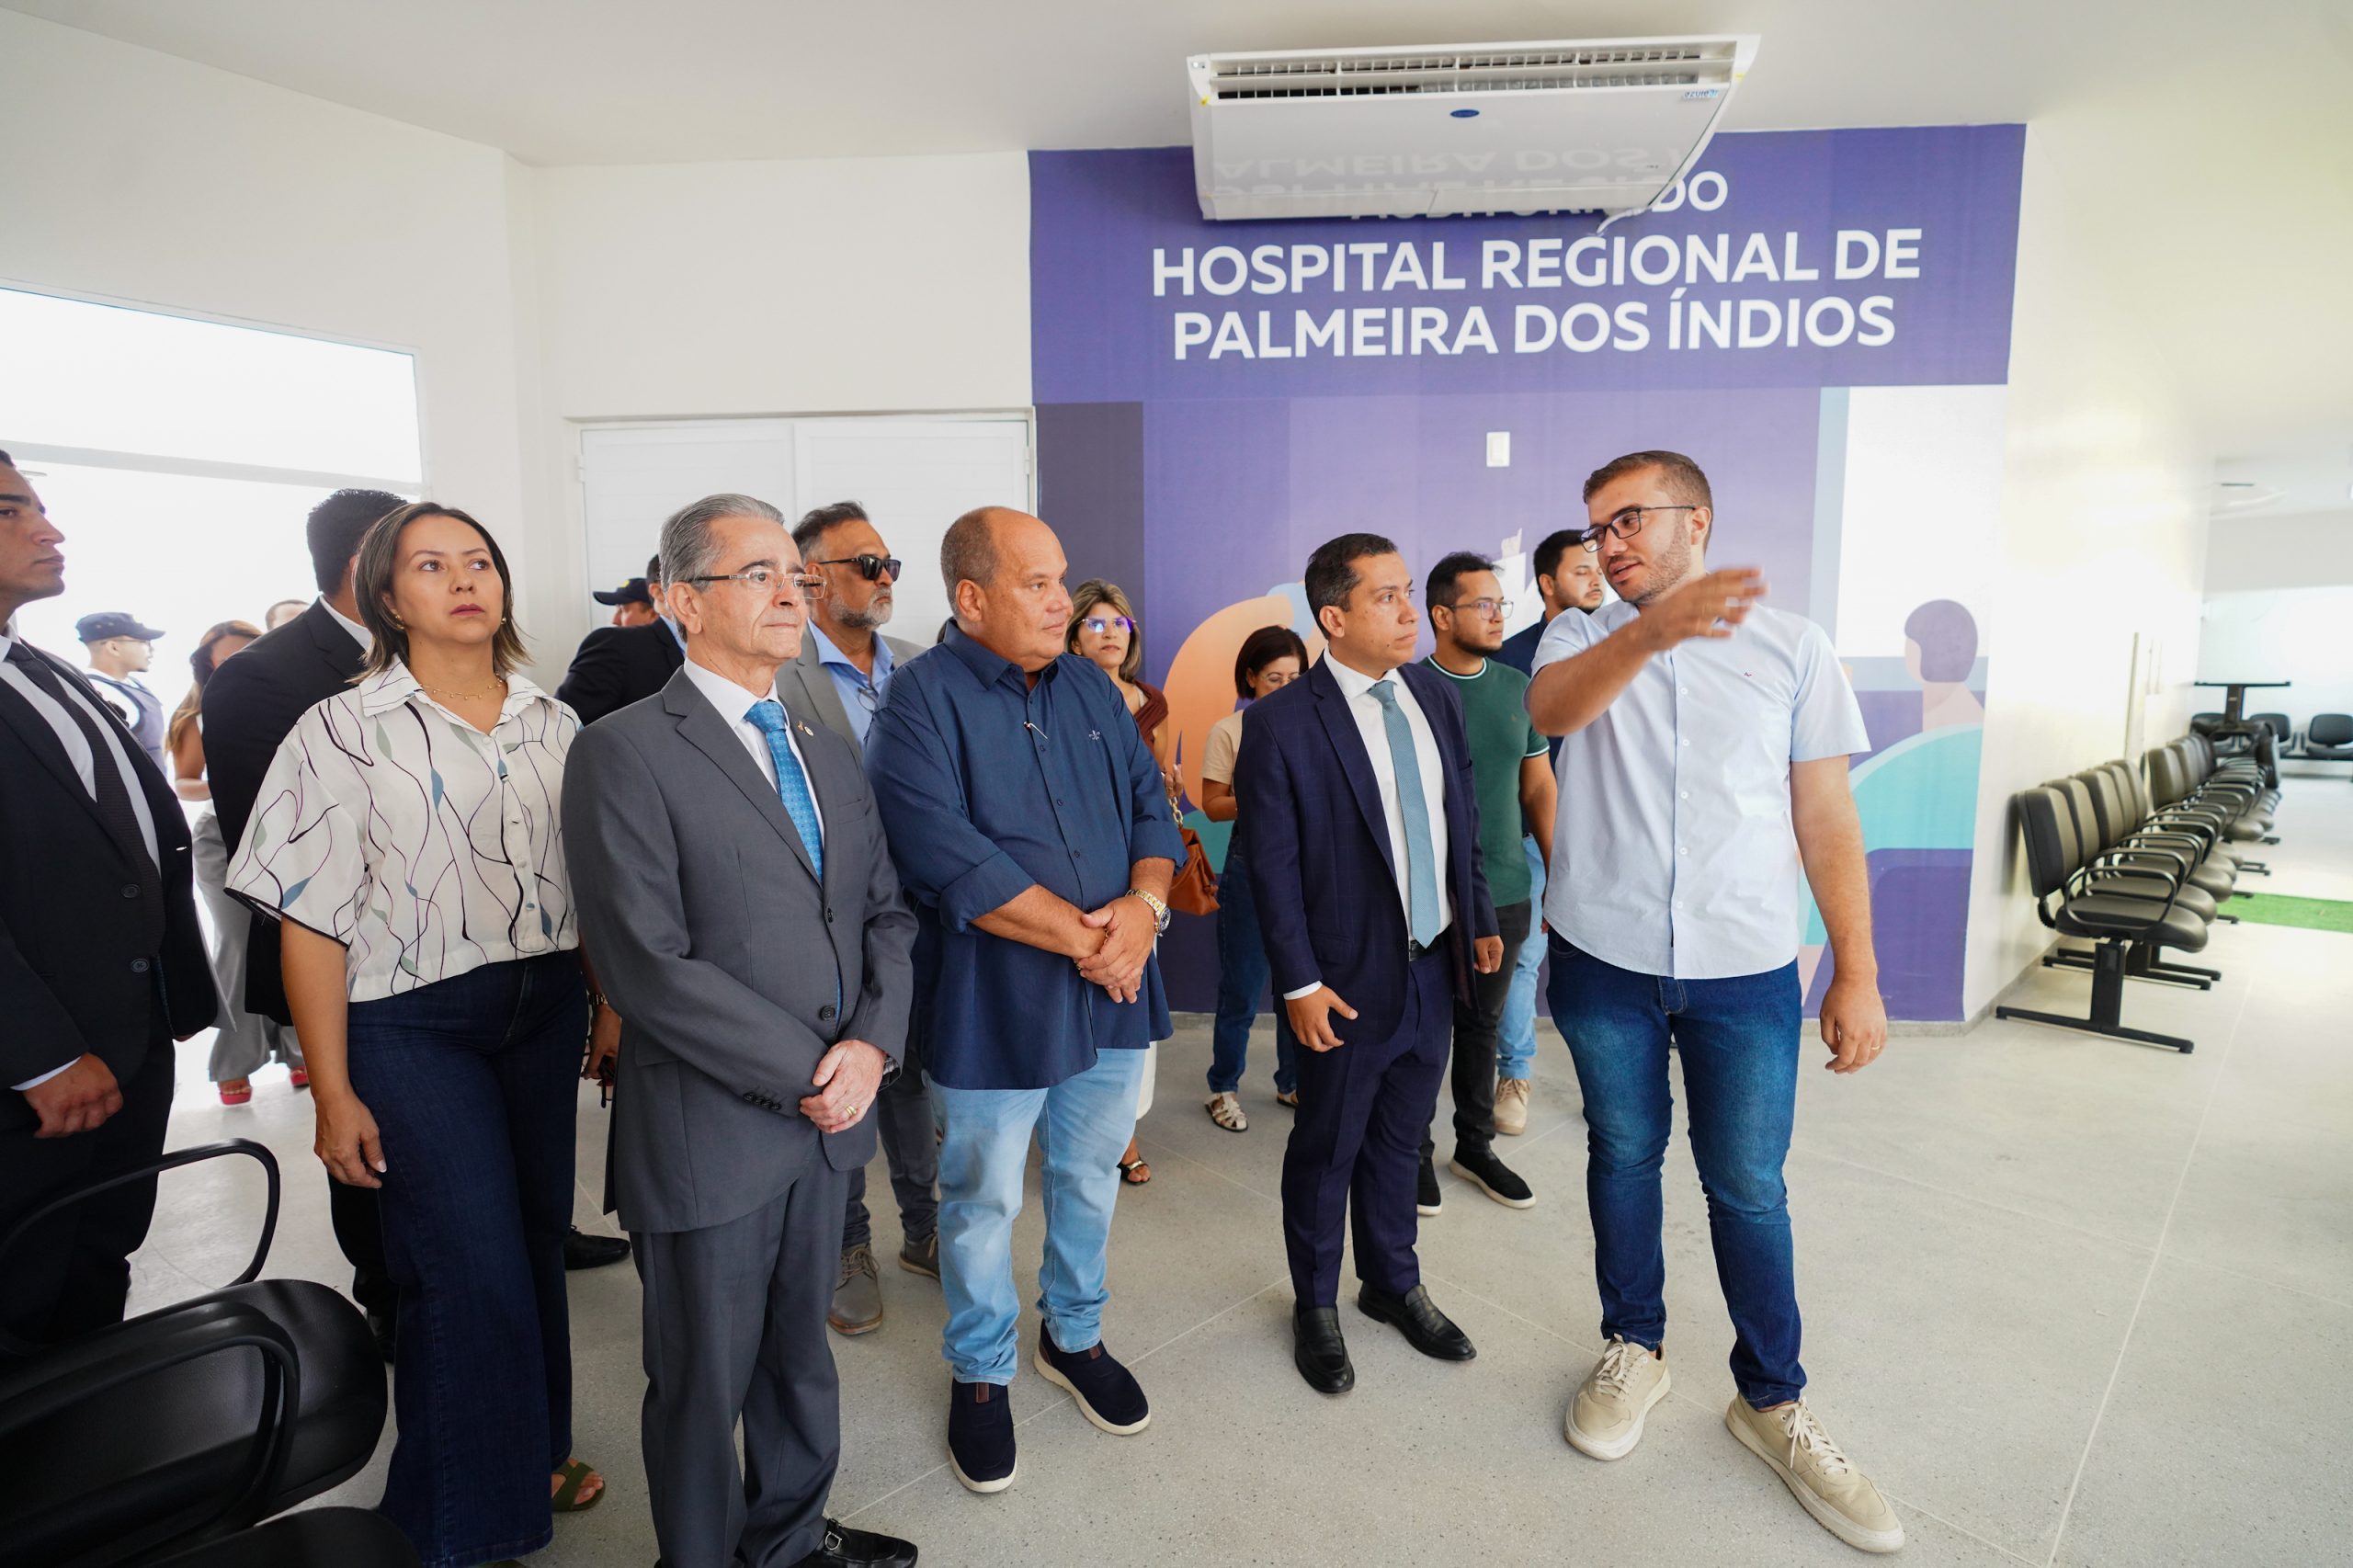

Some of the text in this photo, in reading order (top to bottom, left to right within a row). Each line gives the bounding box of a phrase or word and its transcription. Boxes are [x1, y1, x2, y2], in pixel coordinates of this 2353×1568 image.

[1652, 171, 1728, 212] DO
[1153, 228, 1923, 297] HOSPITAL REGIONAL DE
[1174, 287, 1895, 360] PALMEIRA DOS ÍNDIOS
